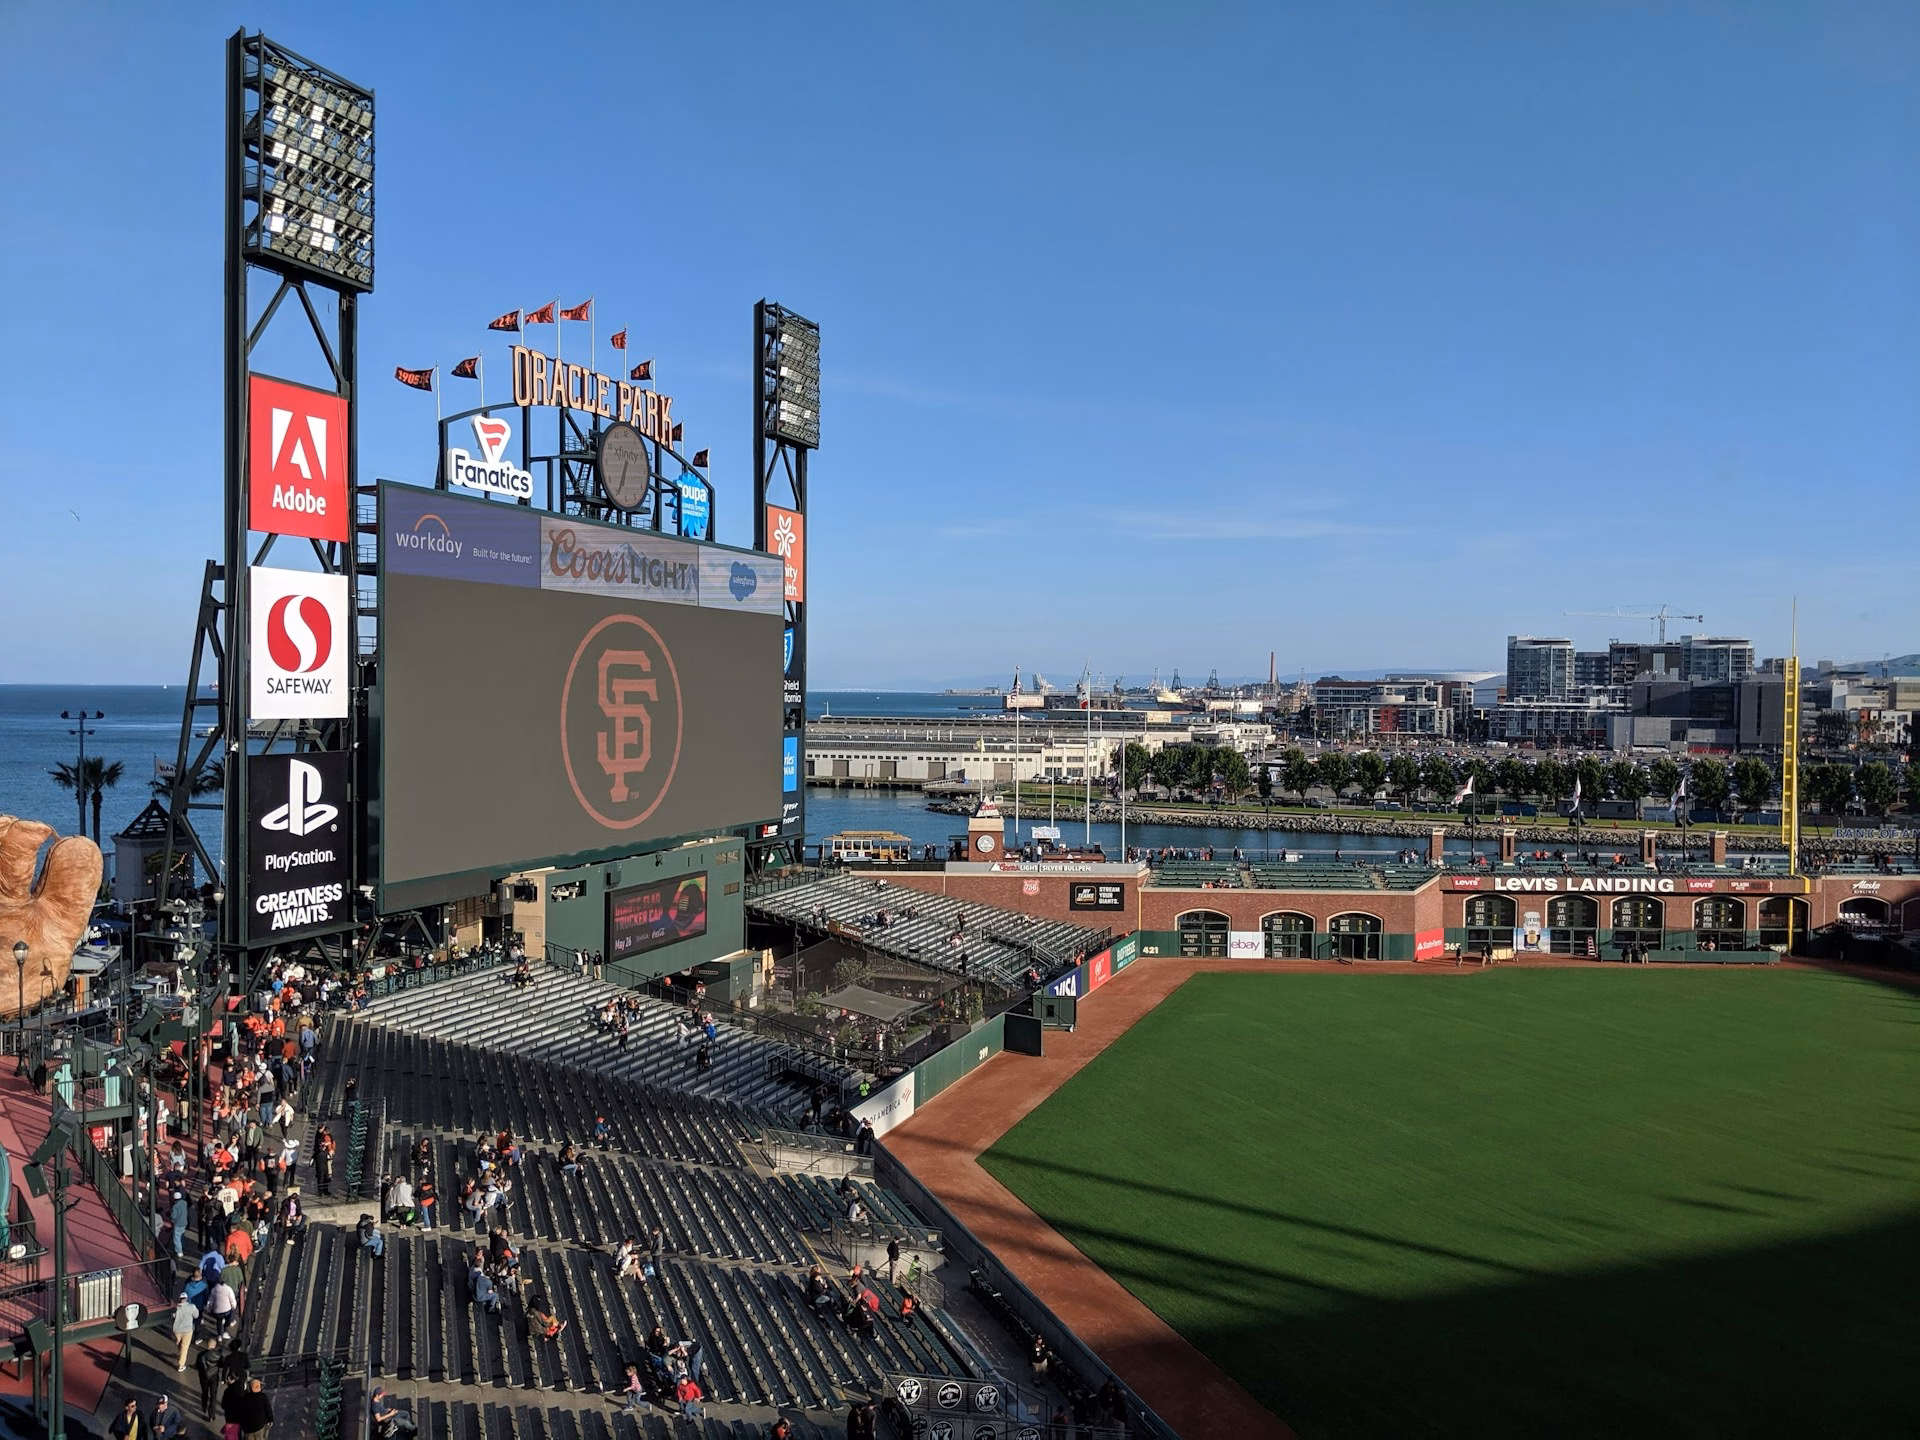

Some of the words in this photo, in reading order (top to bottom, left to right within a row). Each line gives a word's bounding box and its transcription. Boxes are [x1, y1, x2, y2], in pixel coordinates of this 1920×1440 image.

[510, 345, 611, 418] ORACLE
[616, 380, 674, 451] PARK
[614, 446, 638, 464] xfinity
[455, 454, 530, 493] Fanatics
[272, 484, 326, 516] Adobe
[396, 530, 463, 559] workday
[473, 547, 488, 558] Built
[489, 550, 498, 561] for
[500, 551, 511, 562] the
[549, 528, 627, 583] Coors
[630, 558, 688, 590] LIGHT
[732, 575, 755, 587] salesforce
[266, 677, 332, 695] SAFEWAY
[1836, 828, 1876, 838] BANK
[265, 848, 334, 872] PlayStation
[998, 863, 1020, 871] Coors
[1567, 878, 1674, 892] LANDING
[1853, 880, 1880, 889] Alaska
[256, 883, 342, 915] GREATNESS
[271, 903, 329, 931] AWAITS
[649, 907, 663, 922] CAP
[615, 937, 625, 951] May
[1143, 946, 1158, 954] 421
[1231, 939, 1260, 951] ebay
[1054, 975, 1076, 996] VISA
[877, 1099, 901, 1120] AMERICA
